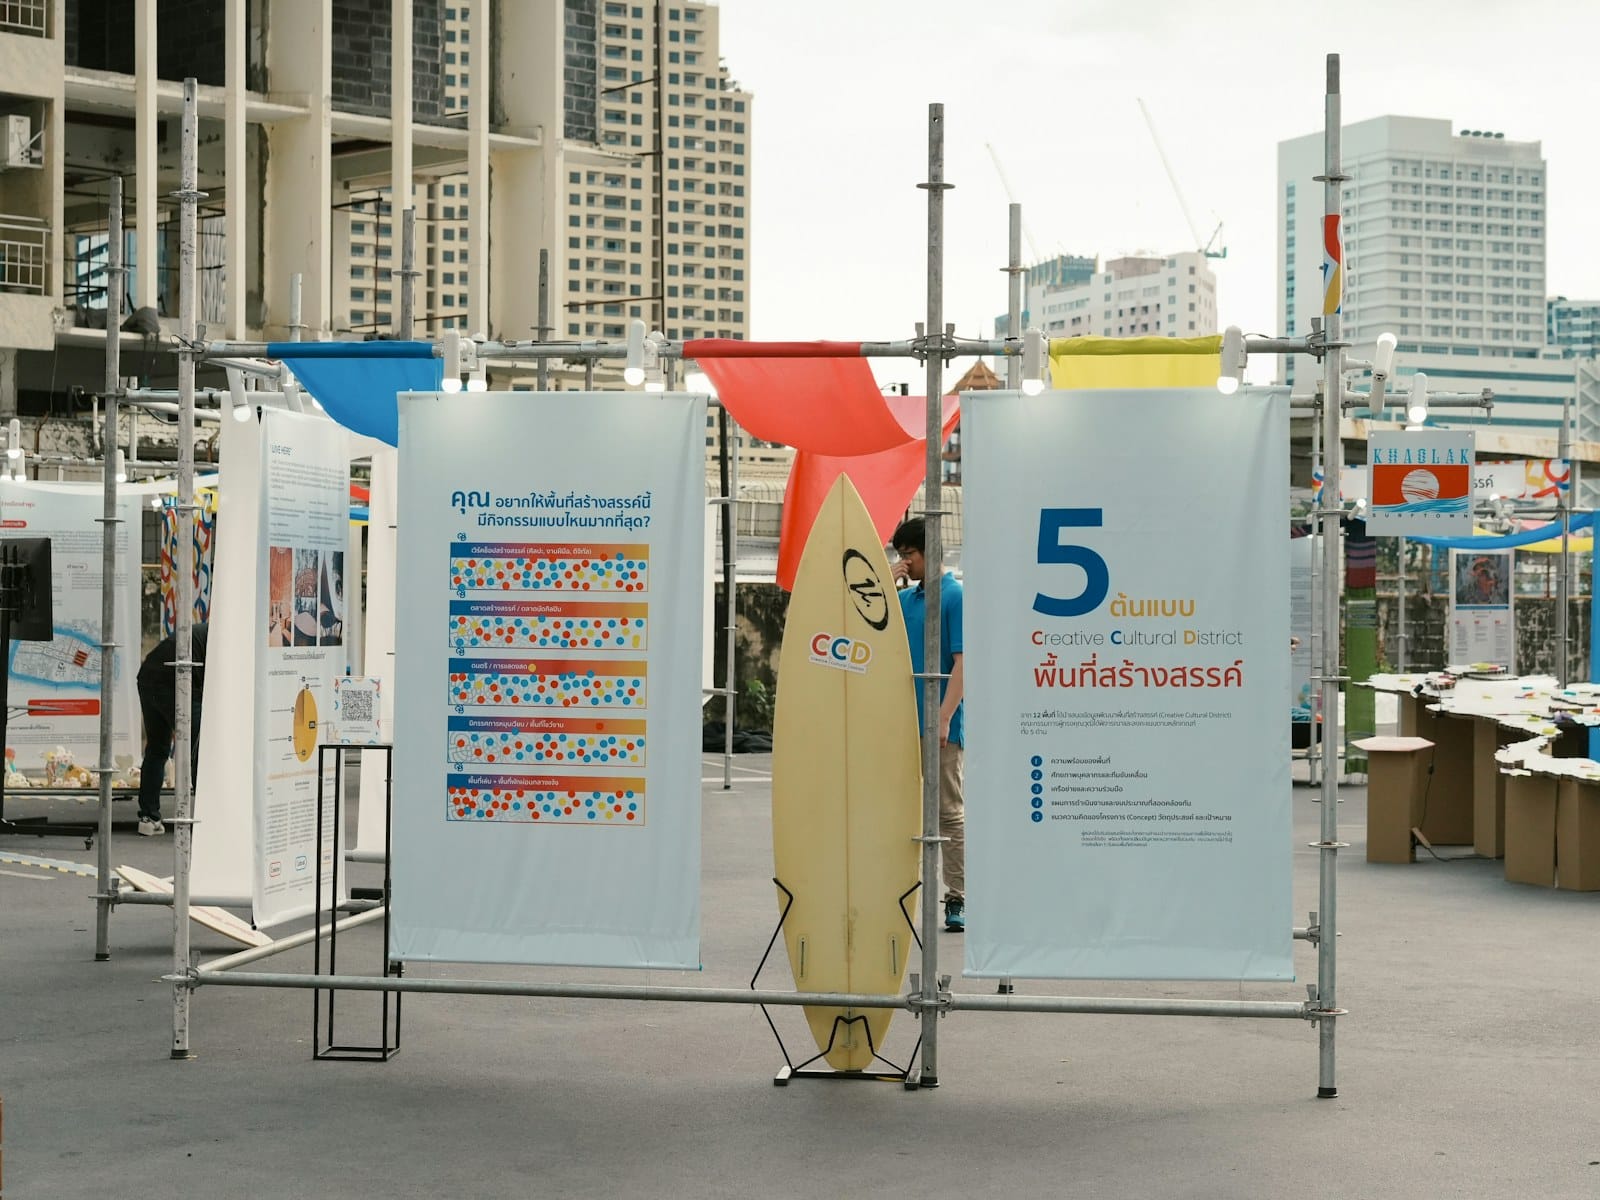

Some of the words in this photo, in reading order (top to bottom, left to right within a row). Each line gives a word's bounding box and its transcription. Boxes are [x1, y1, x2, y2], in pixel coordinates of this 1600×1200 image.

[451, 490, 491, 514] คุณ
[495, 491, 652, 509] อยากให้พื้นที่สร้างสรรค์นี้
[477, 511, 651, 531] มีกิจกรรมแบบไหนมากที่สุด?
[1032, 507, 1110, 618] 5
[1110, 592, 1195, 617] ต้นแบบ
[811, 634, 871, 664] CCD
[1031, 630, 1104, 646] Creative
[1110, 630, 1177, 646] Cultural
[1183, 630, 1243, 645] District
[1033, 652, 1243, 688] พื้นที่สร้างสรรค์
